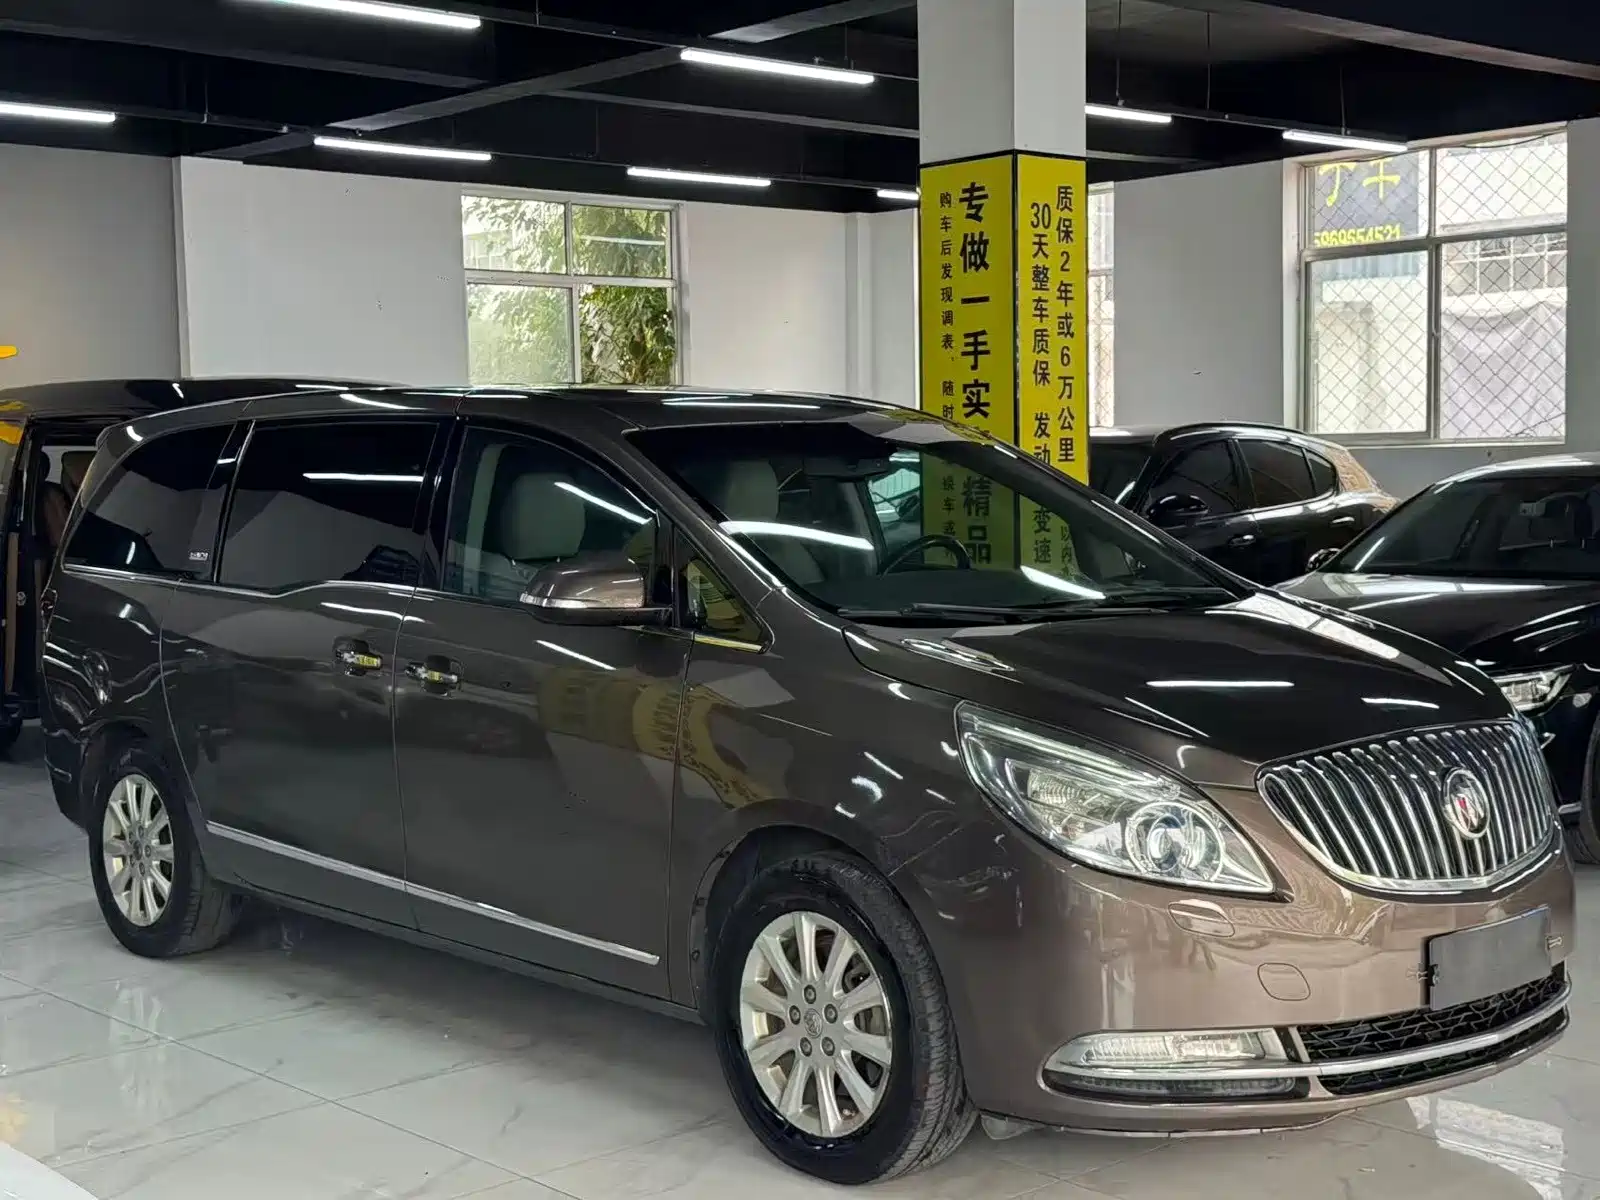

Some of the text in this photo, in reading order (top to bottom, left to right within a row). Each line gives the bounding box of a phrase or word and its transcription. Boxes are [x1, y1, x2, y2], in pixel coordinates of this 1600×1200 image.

[1030, 203, 1051, 386] 30天整车质保
[1056, 186, 1075, 463] 质保2年或6万公里
